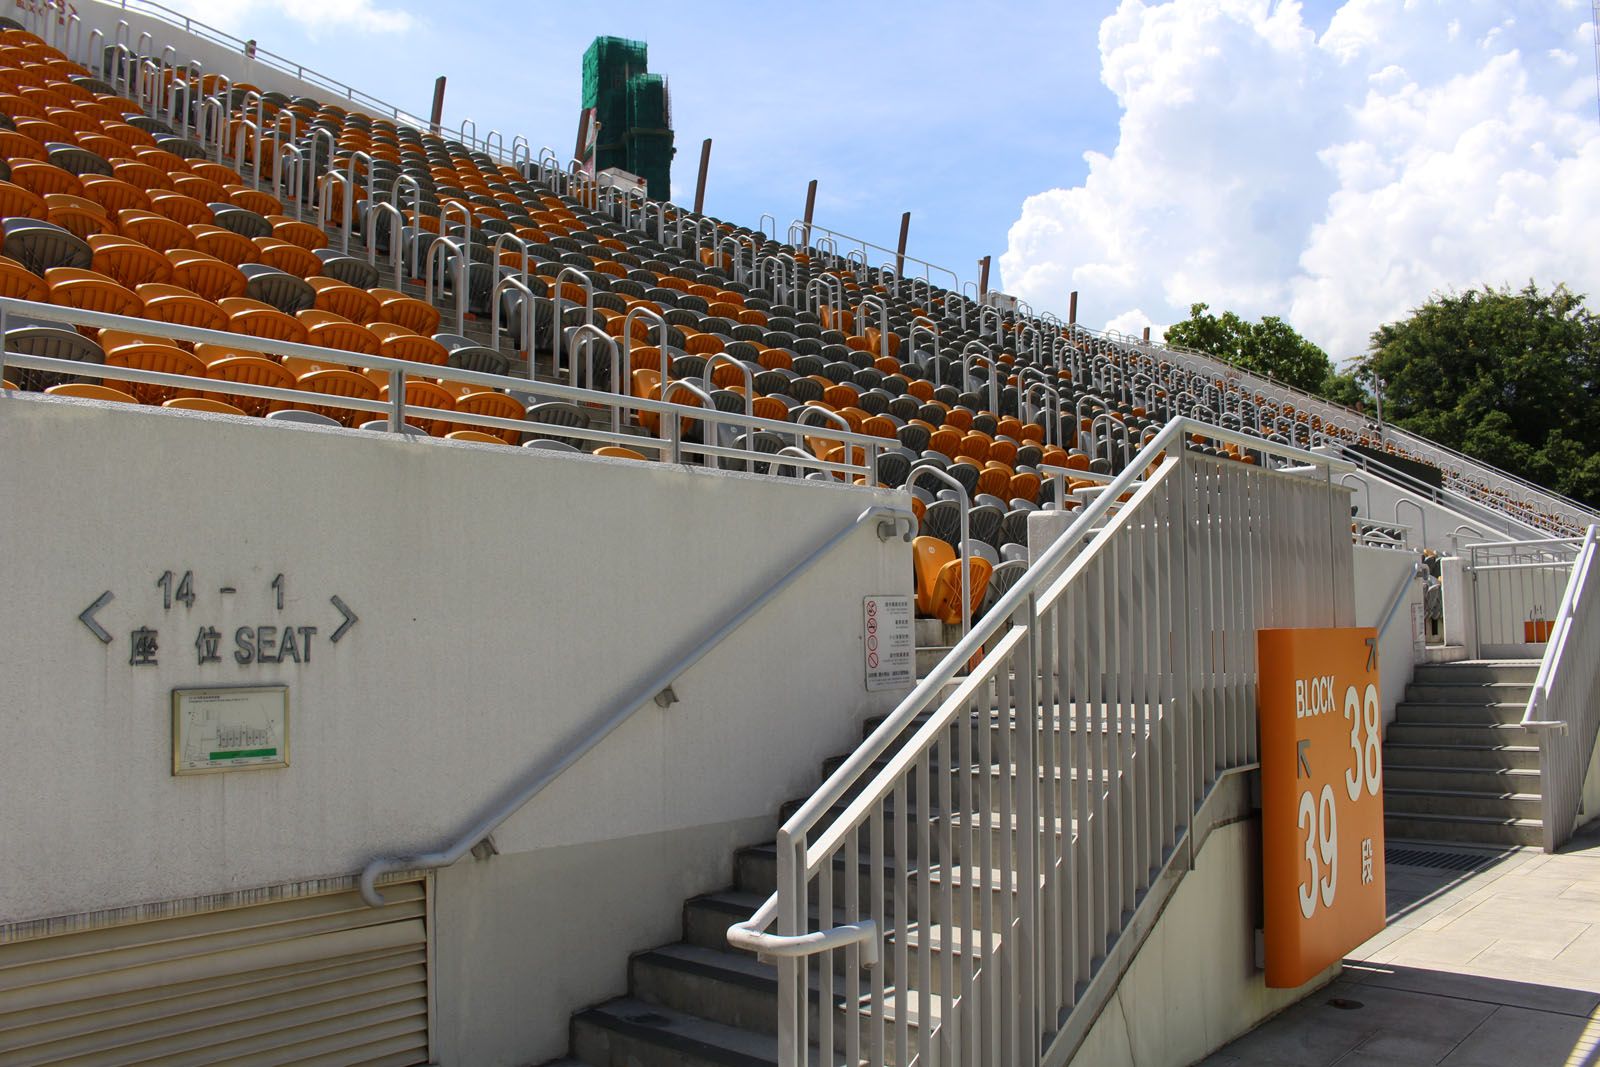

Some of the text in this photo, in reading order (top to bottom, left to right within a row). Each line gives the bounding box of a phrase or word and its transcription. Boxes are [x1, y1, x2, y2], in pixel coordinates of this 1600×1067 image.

[157, 570, 196, 609] 14
[271, 573, 284, 609] 1
[234, 626, 317, 665] SEAT
[1296, 675, 1336, 718] BLOCK
[1344, 684, 1381, 801] 38
[1298, 784, 1338, 919] 39
[1361, 838, 1373, 886] 段
